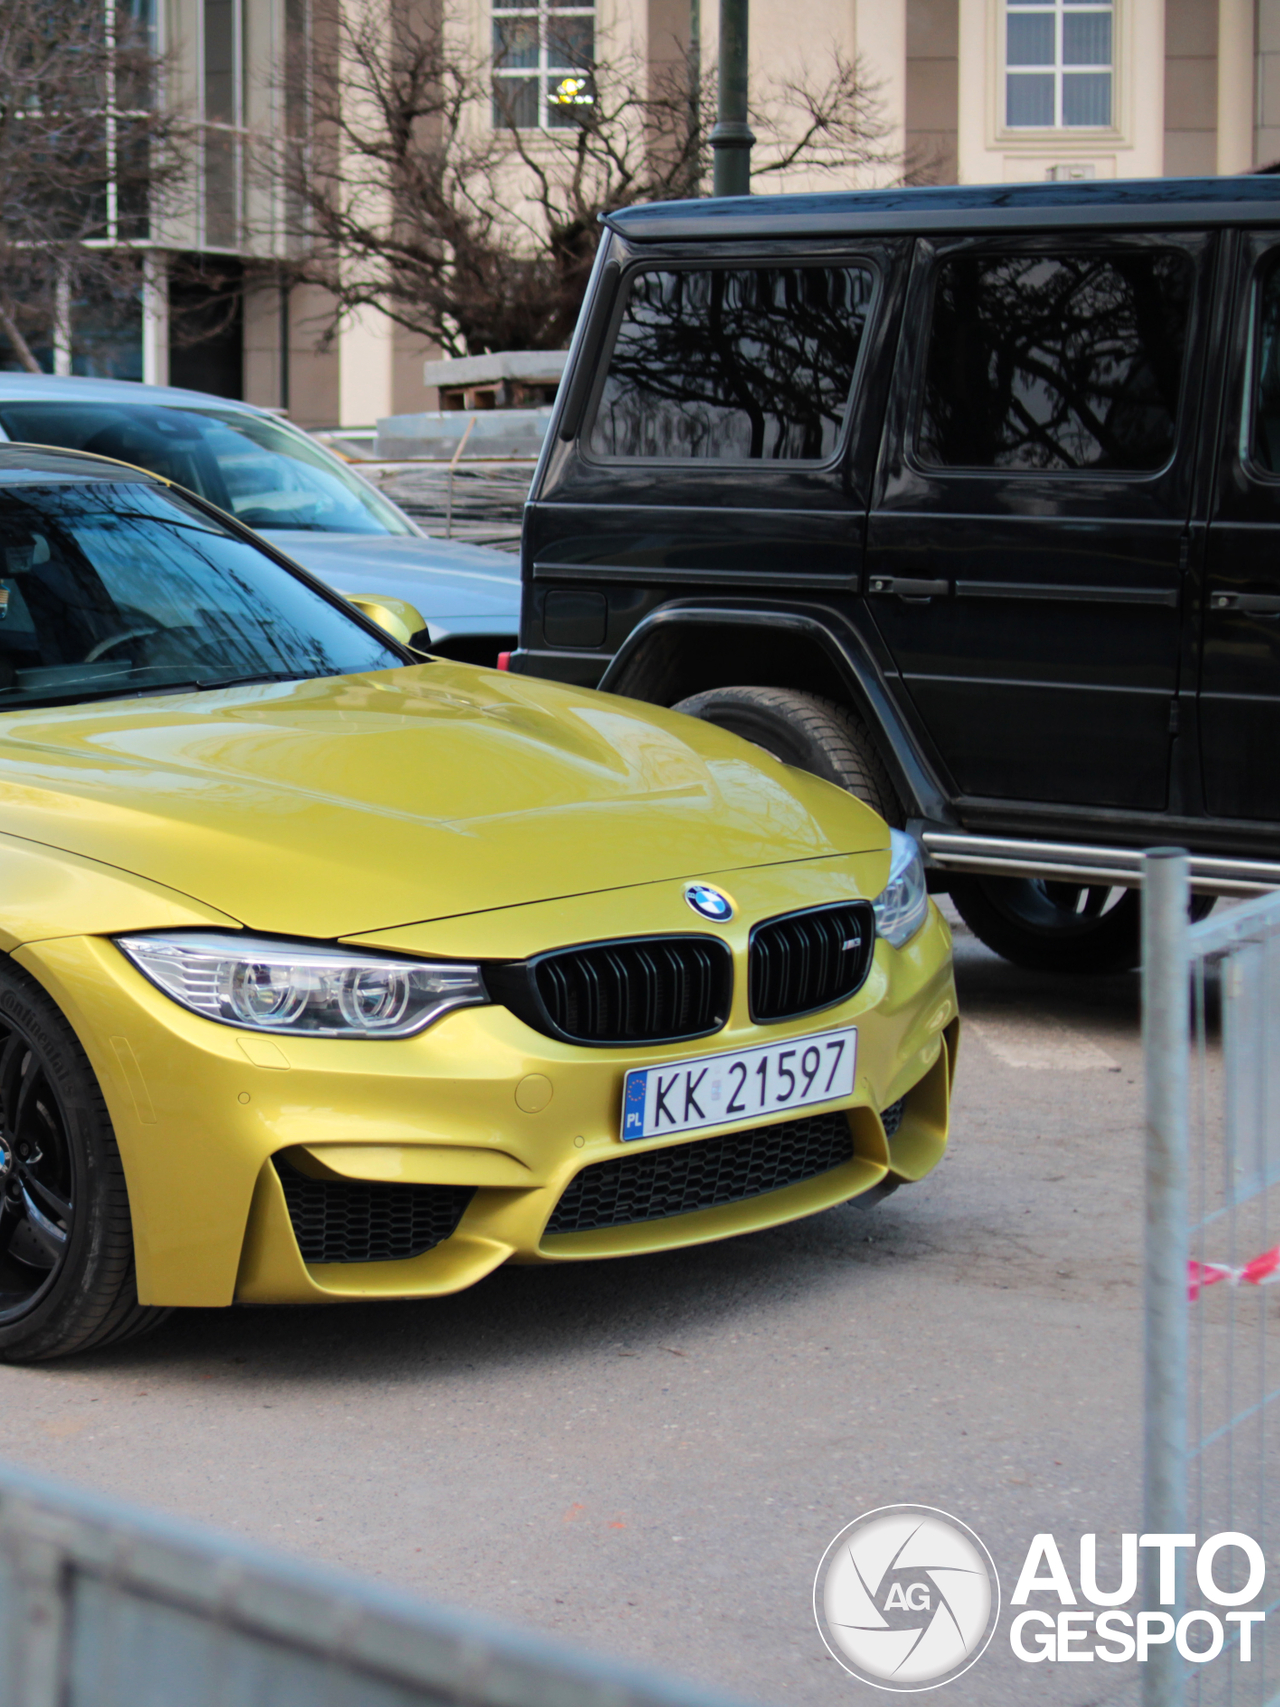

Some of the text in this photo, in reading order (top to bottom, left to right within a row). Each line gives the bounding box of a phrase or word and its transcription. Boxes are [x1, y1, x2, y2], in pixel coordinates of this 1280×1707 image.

[1, 989, 70, 1081] Continental
[627, 1112, 642, 1128] PL
[654, 1039, 846, 1127] KK 21597
